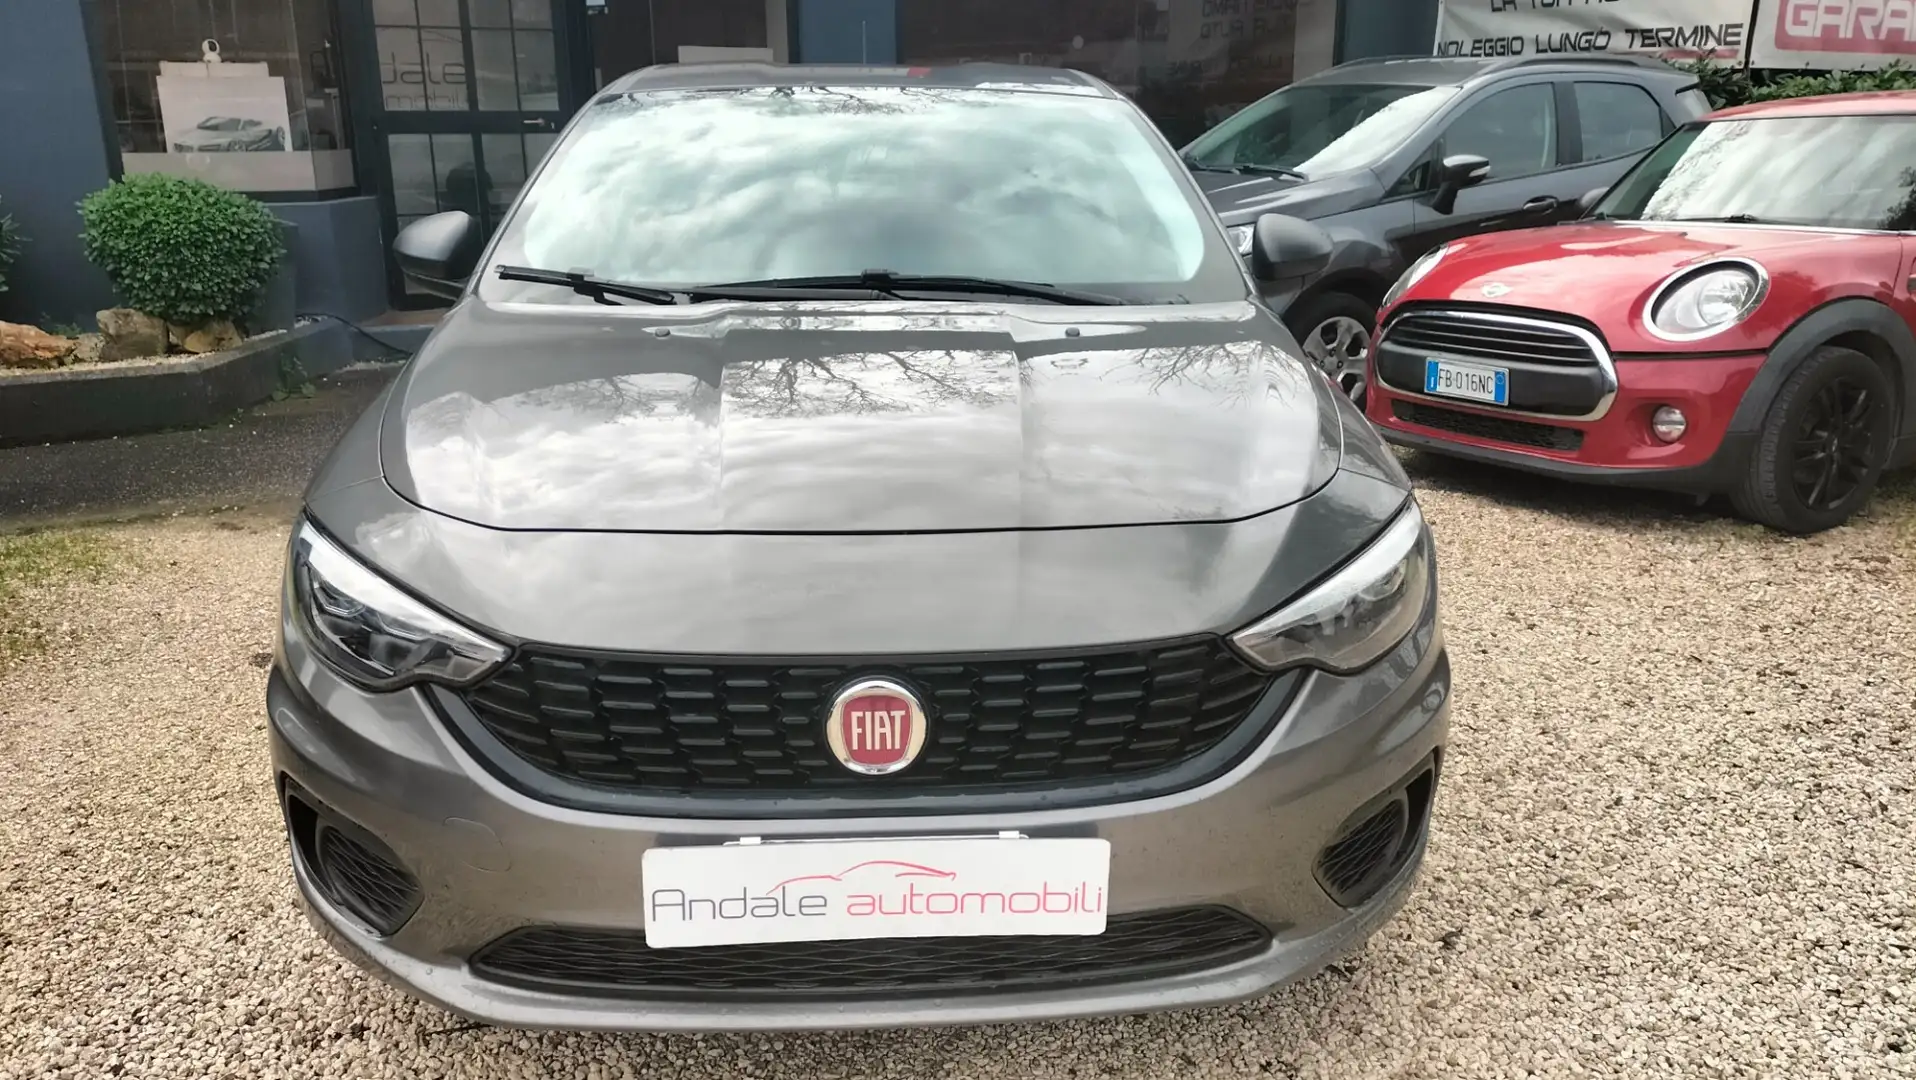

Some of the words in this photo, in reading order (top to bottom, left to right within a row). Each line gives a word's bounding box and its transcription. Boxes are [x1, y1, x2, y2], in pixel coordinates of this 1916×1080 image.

[1437, 36, 1524, 58] NOLEGGIO
[1625, 23, 1743, 48] TERMINE
[1785, 0, 1916, 41] GARA
[850, 709, 906, 752] FIAT
[652, 886, 827, 922] Andale
[846, 881, 1102, 916] automobili
